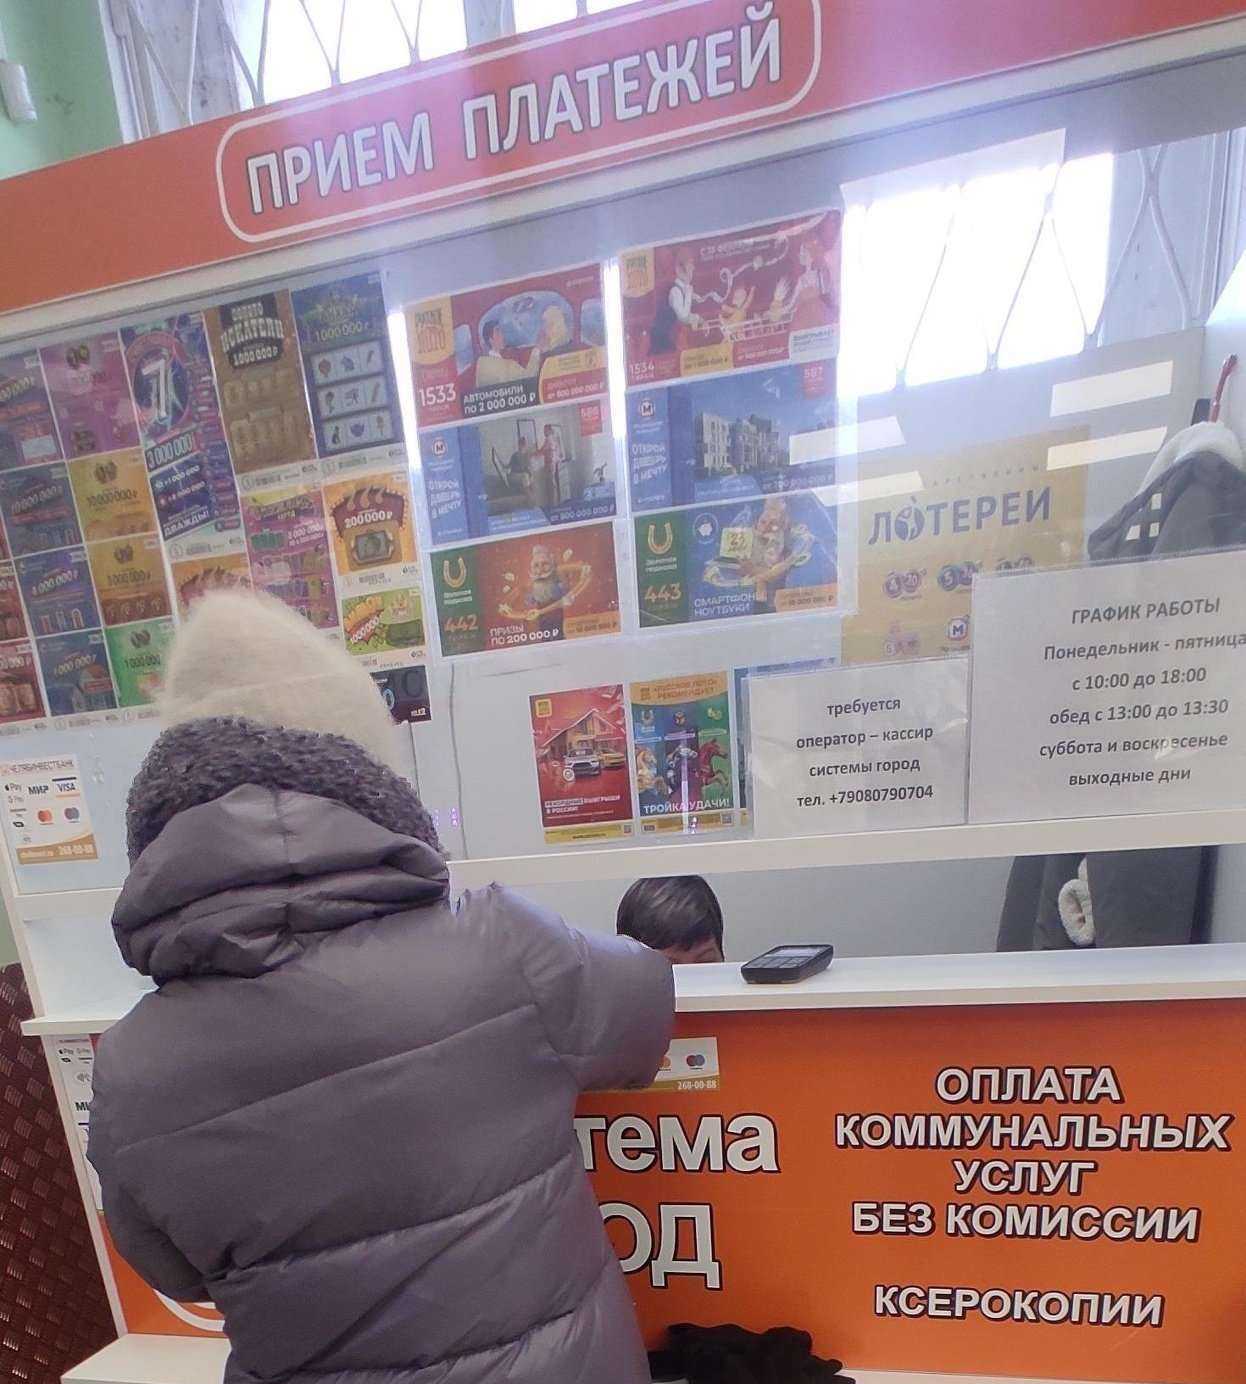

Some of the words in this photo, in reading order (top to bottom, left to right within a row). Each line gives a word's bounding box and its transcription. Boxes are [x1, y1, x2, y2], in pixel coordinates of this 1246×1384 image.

[246, 112, 434, 215] ПРИЕМ
[461, 2, 781, 161] ПЛАТЕЖЕЙ
[630, 361, 655, 376] 1534
[419, 384, 457, 407] 1533
[463, 385, 524, 404] АВТОМОБИЛИ
[479, 401, 486, 412] 2
[487, 399, 506, 412] 000
[507, 395, 527, 407] 000
[868, 487, 1054, 545] ЛОТЕРЕИ
[644, 584, 681, 603] 443
[1072, 604, 1142, 624] ГРАФИК
[1146, 597, 1221, 619] РАБОТЫ
[444, 615, 478, 632] 442
[507, 632, 527, 644] 200
[528, 630, 550, 641] 000
[1044, 640, 1160, 660] Понедельник
[1175, 633, 1246, 650] пятница
[1072, 679, 1081, 690] с
[1085, 672, 1130, 690] 10:00
[1133, 673, 1156, 689] до
[1160, 667, 1207, 684] 18:00
[827, 699, 901, 718] требуется
[1050, 708, 1090, 725] обед
[1094, 710, 1103, 721] с
[1107, 704, 1151, 721] 13:00
[1155, 705, 1178, 720] до
[1183, 699, 1229, 716] 13:30
[796, 732, 866, 749] оператор
[882, 727, 934, 741] кассир
[1039, 739, 1102, 759] суббота
[1107, 742, 1118, 752] и
[1122, 734, 1228, 752] воскресенье
[809, 762, 873, 777] системы
[876, 759, 921, 773] город
[1069, 769, 1155, 787] выходные
[1158, 767, 1191, 783] дни
[28, 785, 49, 795] МИР
[57, 783, 76, 792] VISA
[797, 796, 825, 808] тел.
[829, 785, 934, 804] +79080790704
[689, 798, 730, 812] УДАЧИ!
[677, 1080, 717, 1091] 268-00-88
[936, 1066, 1124, 1103] ОПЛАТА
[834, 1113, 1233, 1151] КОММУНАЛЬНЫХ
[953, 1158, 1099, 1195] УСЛУГ
[852, 1201, 935, 1235] БЕЗ
[945, 1203, 1201, 1242] КОМИССИИ
[873, 1284, 1165, 1327] КСЕРОКОПИИ
